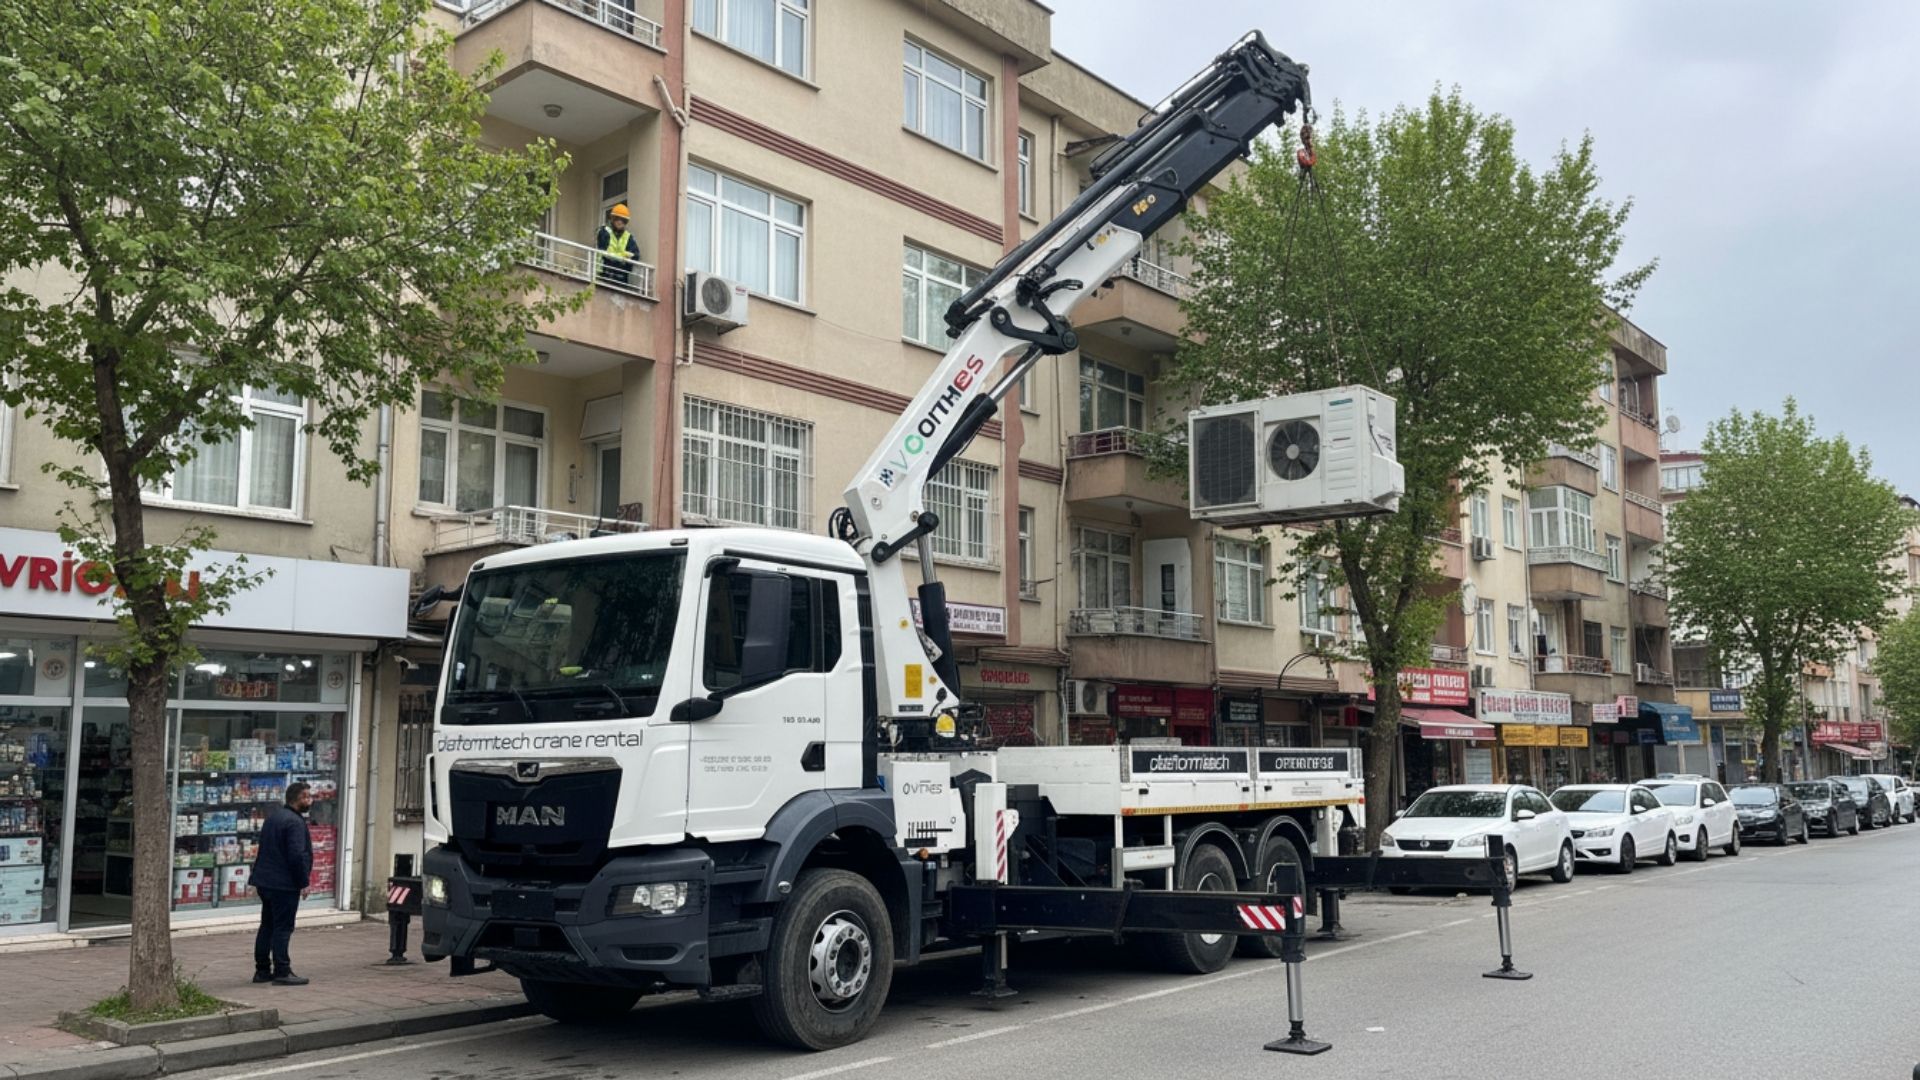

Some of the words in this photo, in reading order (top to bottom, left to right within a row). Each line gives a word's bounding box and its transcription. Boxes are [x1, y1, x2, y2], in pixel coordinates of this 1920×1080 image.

[533, 734, 582, 749] crane
[585, 729, 644, 747] rental
[496, 806, 565, 826] MAN
